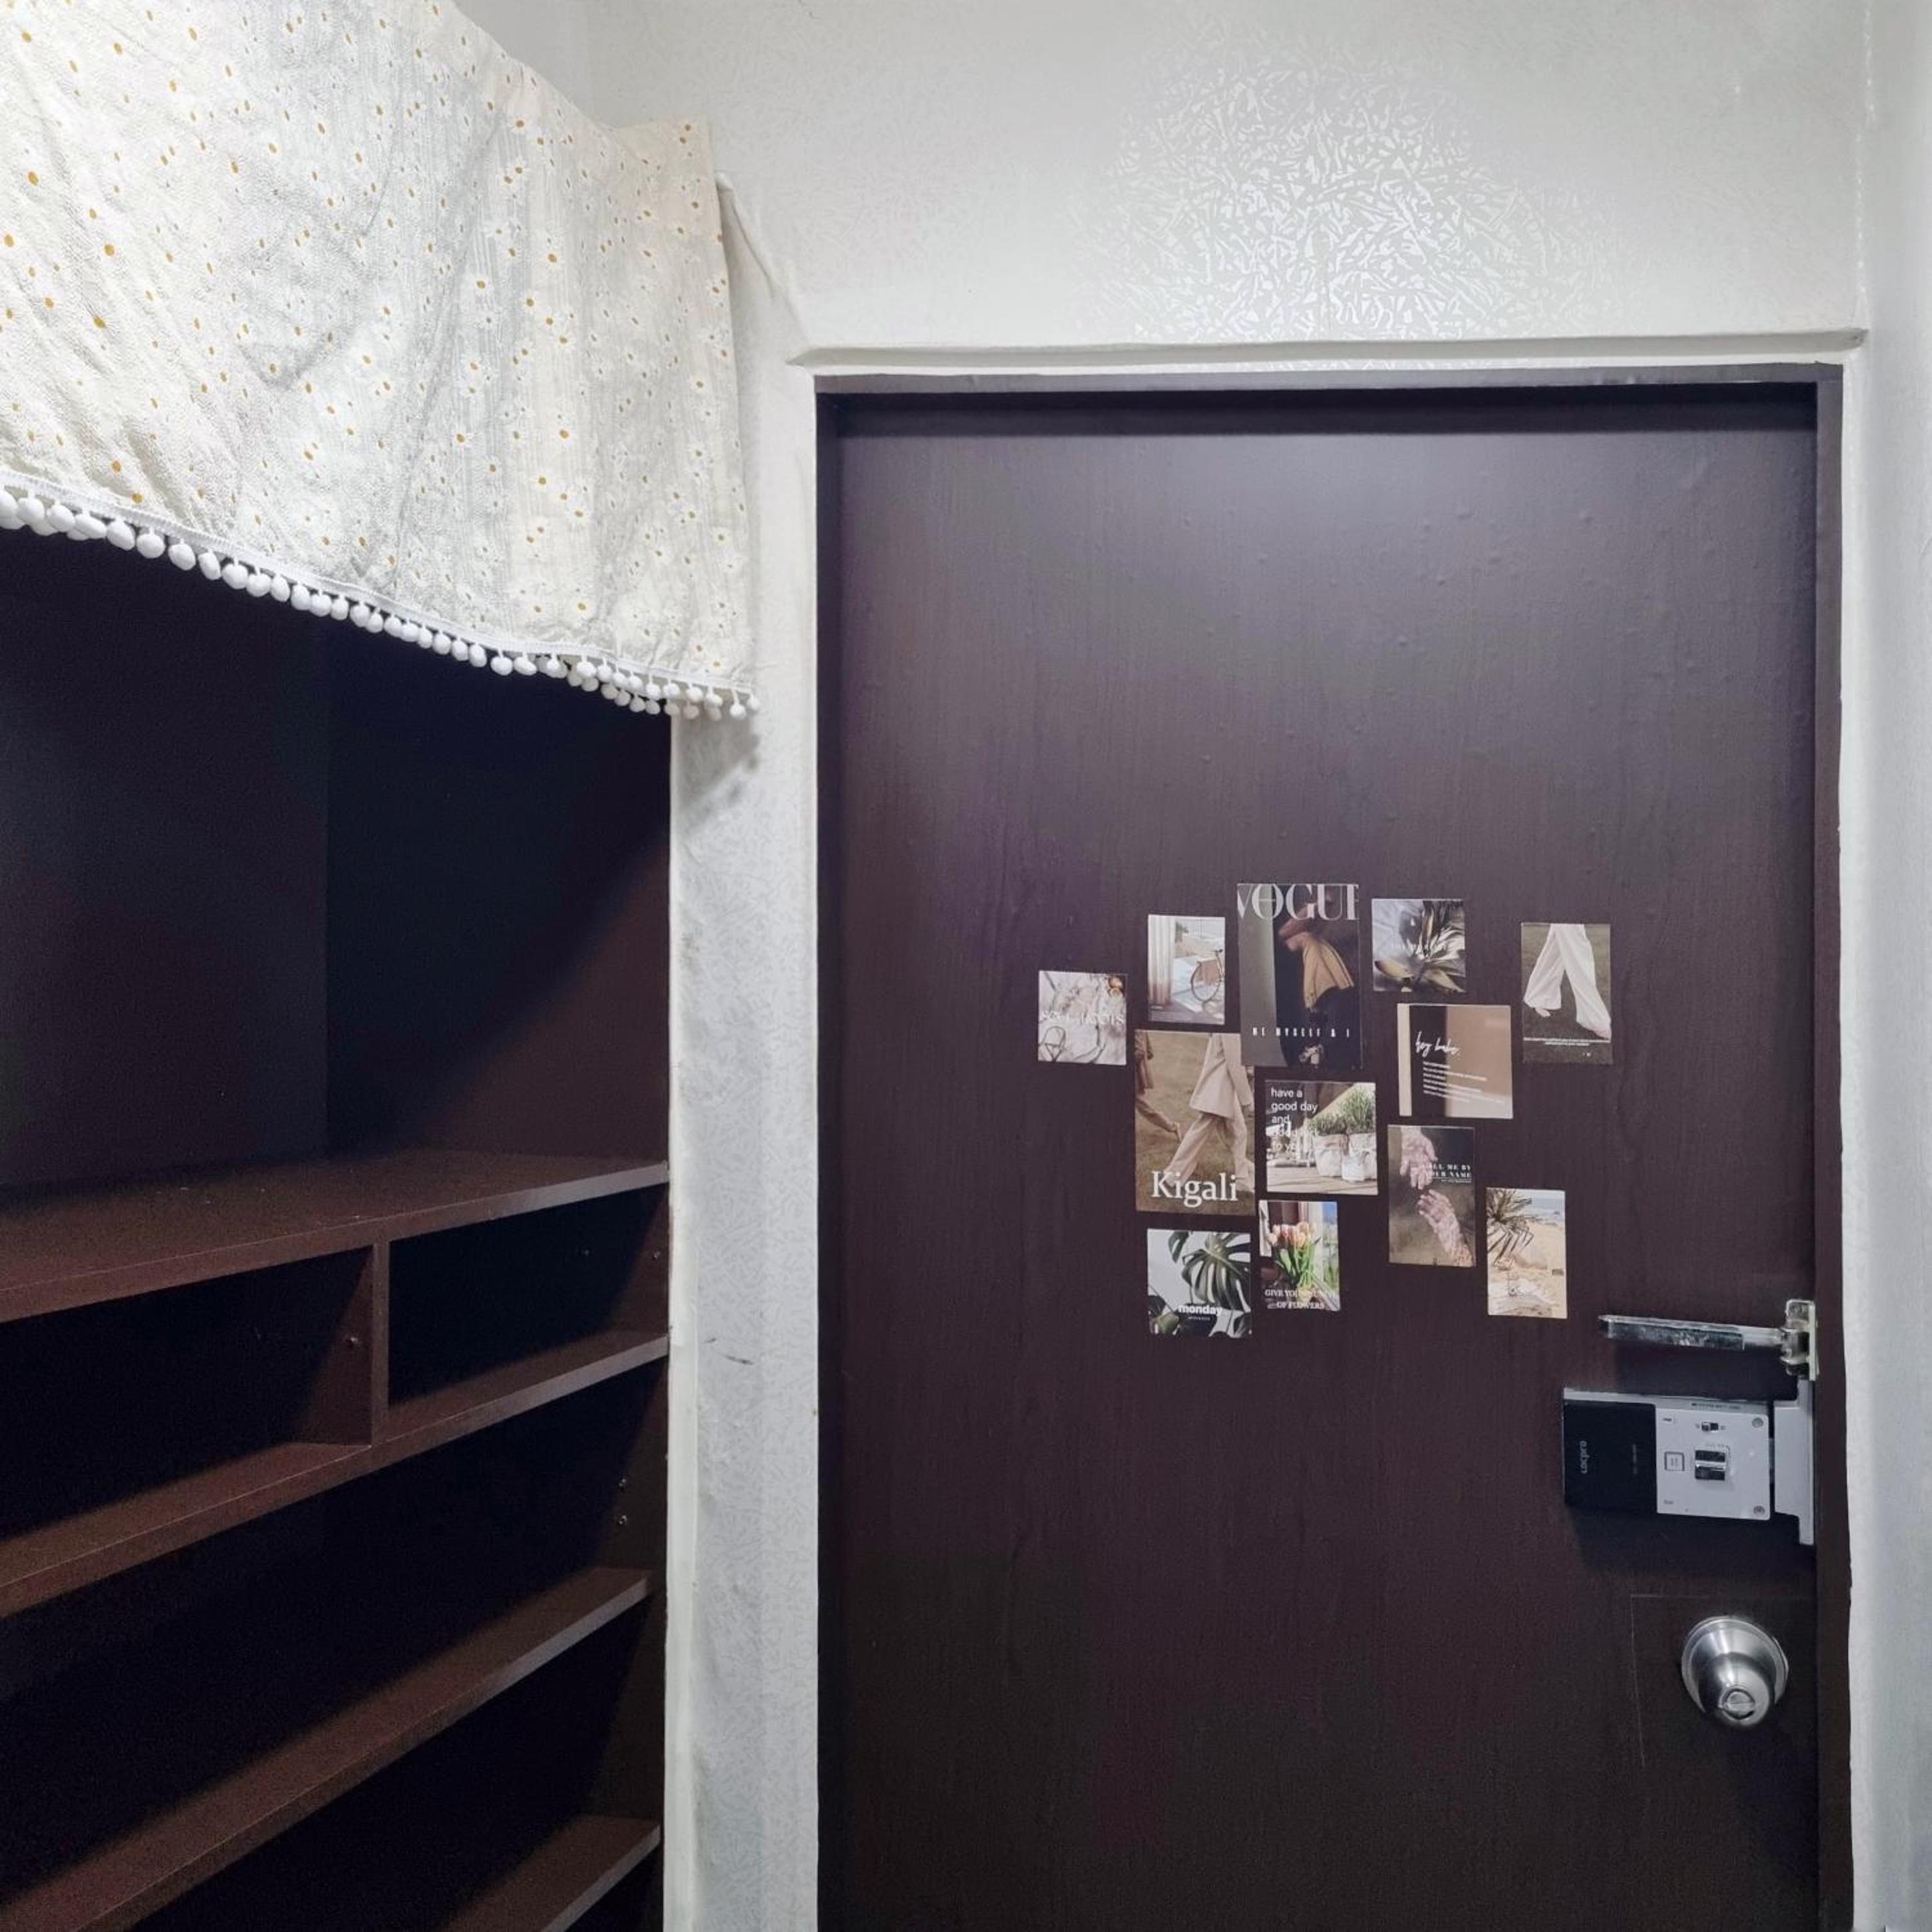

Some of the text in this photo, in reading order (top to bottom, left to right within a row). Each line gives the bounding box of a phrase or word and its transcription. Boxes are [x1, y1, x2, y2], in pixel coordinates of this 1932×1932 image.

[1270, 1087, 1303, 1098] have a
[1271, 1101, 1318, 1114] good day
[1272, 1115, 1290, 1123] and
[1151, 1170, 1239, 1208] Kigali
[1264, 1289, 1284, 1297] GIVE
[1178, 1304, 1223, 1317] monday
